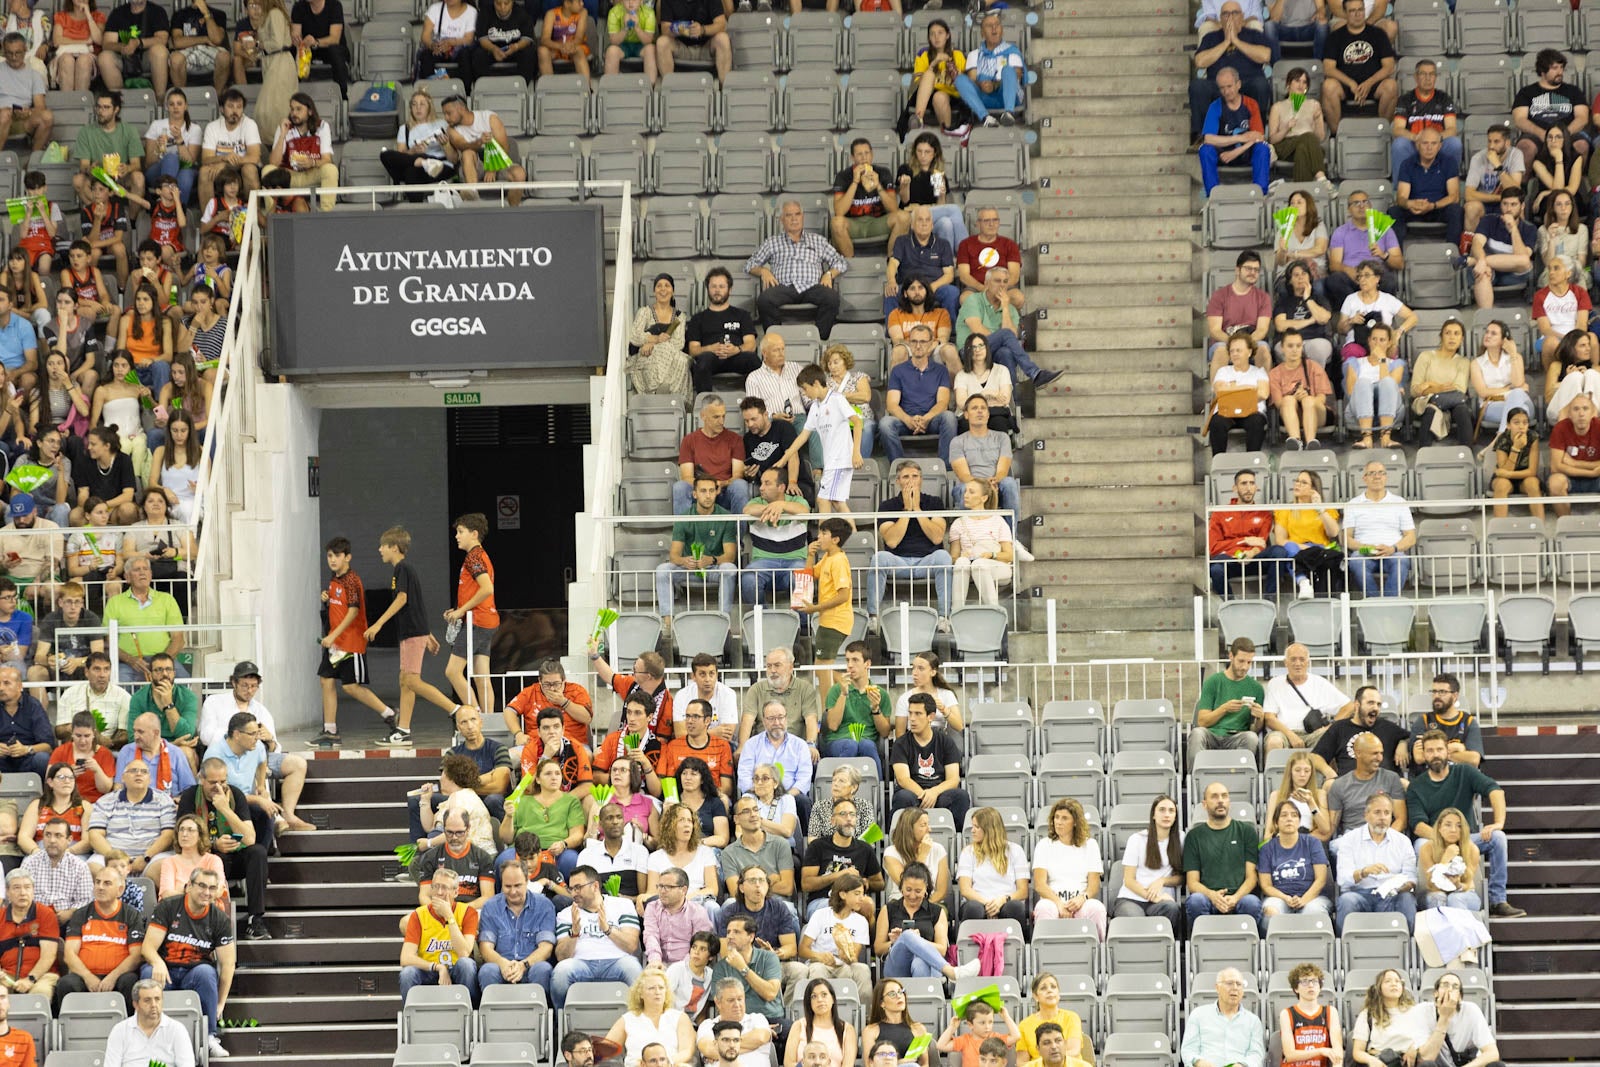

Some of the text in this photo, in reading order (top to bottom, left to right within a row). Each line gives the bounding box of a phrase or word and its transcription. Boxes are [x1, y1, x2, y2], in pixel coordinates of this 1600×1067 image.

[335, 244, 553, 272] AYUNTAMIENTO
[353, 276, 535, 305] DE GRANADA
[446, 393, 479, 404] SALIDA
[184, 653, 192, 664] 2
